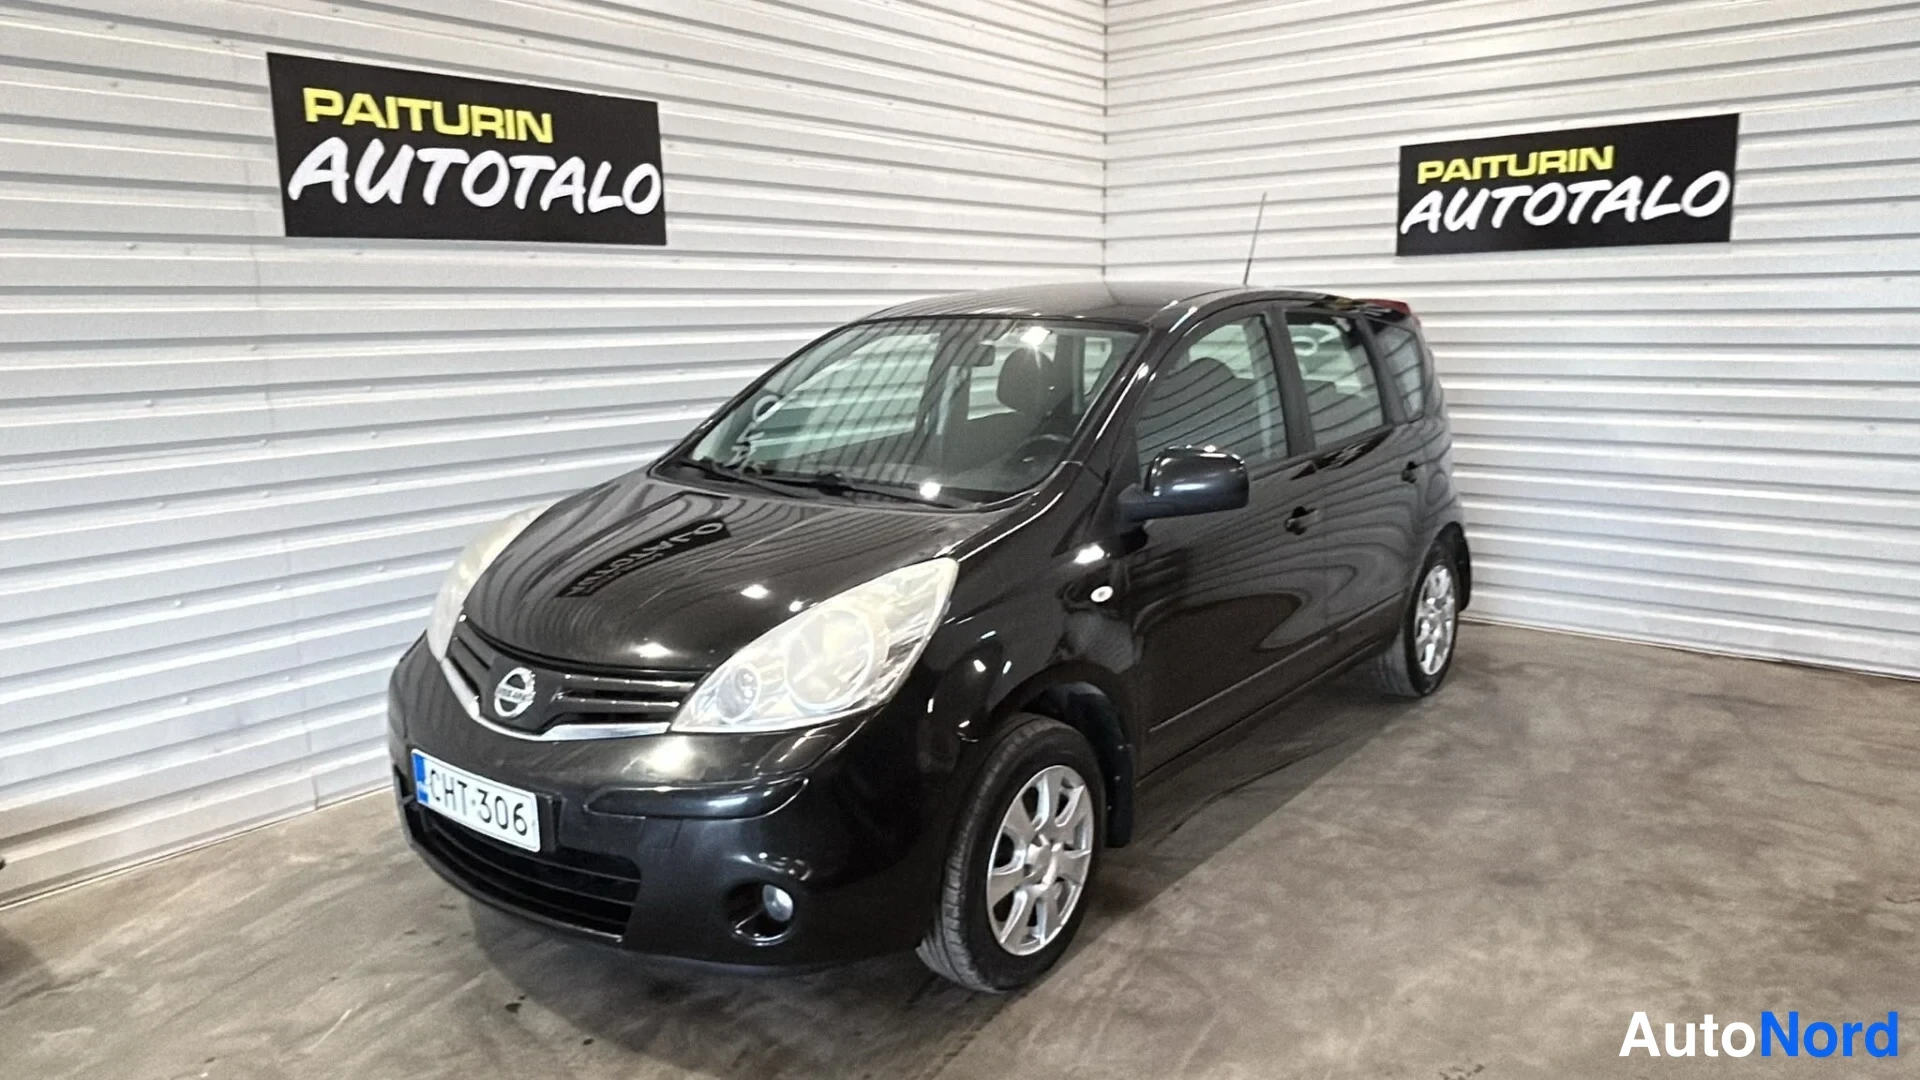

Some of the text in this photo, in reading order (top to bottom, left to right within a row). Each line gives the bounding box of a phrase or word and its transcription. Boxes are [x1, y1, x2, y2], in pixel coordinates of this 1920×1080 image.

[303, 87, 553, 144] PAITURIN
[288, 136, 661, 216] AUTOTALO
[1417, 145, 1615, 185] PAITURIN
[1400, 170, 1732, 235] AUTOTALO
[430, 768, 528, 836] CHT-306
